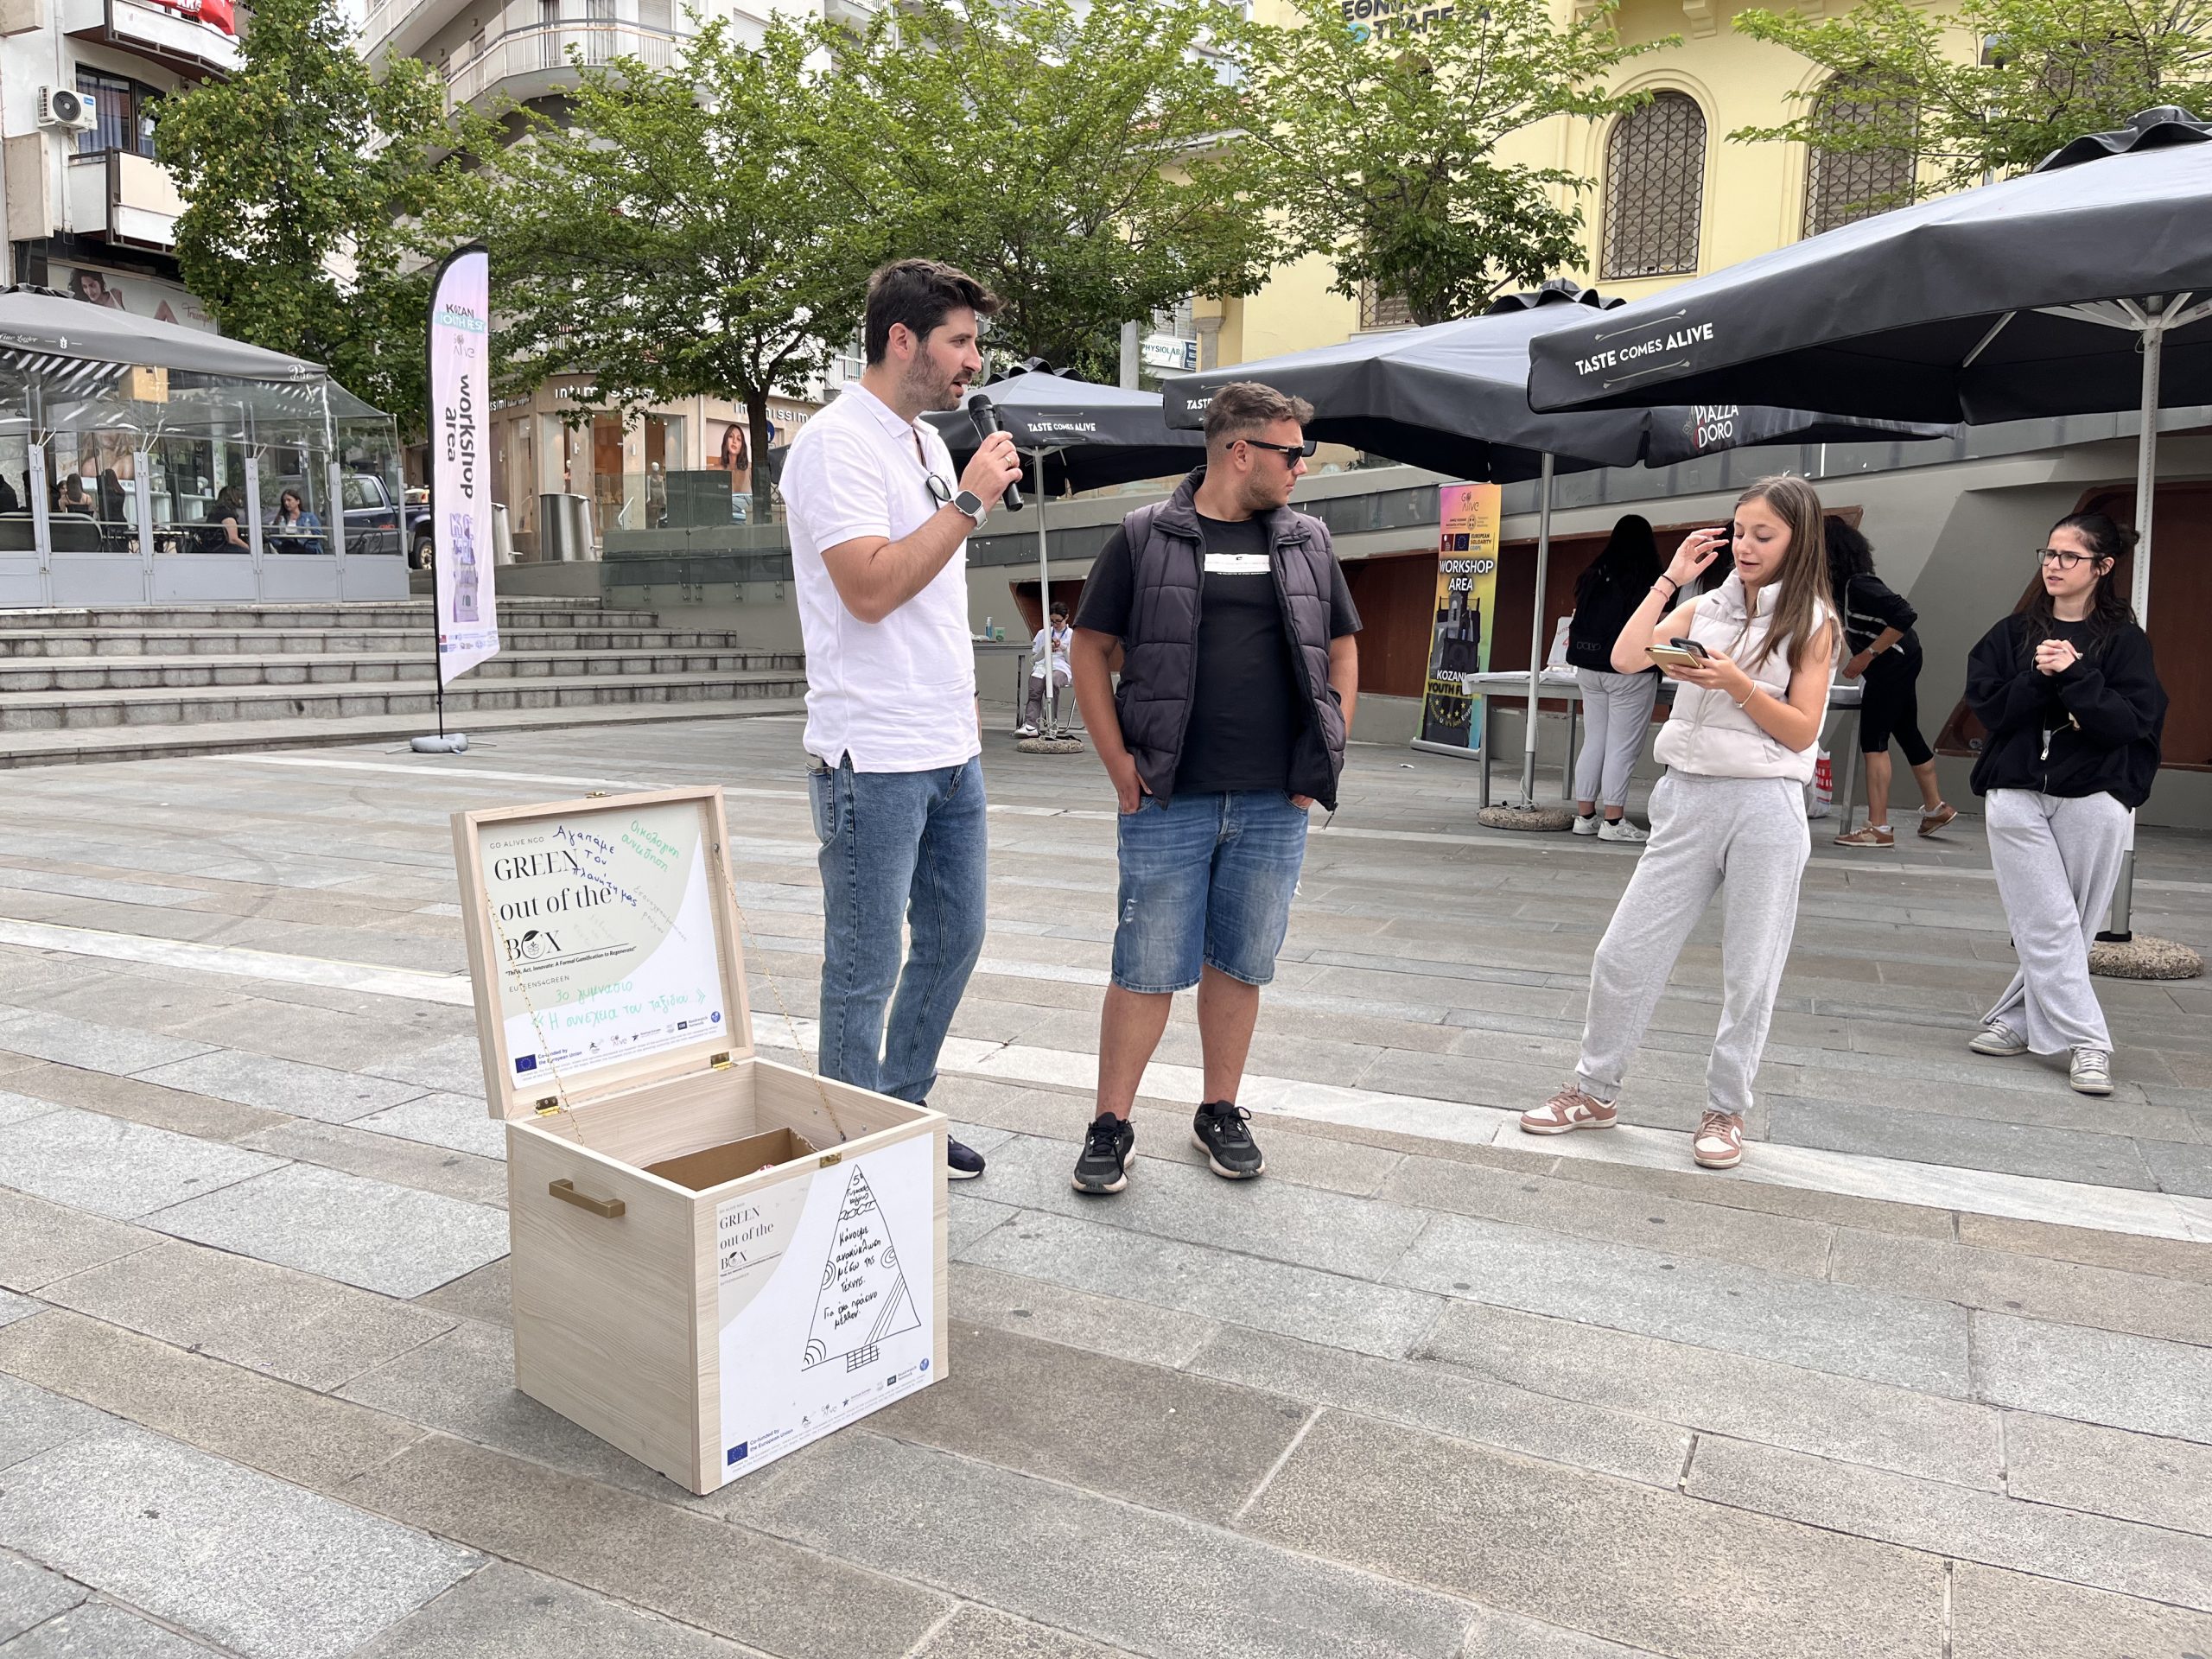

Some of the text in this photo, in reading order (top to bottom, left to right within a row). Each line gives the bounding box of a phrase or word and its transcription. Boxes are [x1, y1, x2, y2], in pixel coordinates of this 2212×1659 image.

[1575, 322, 1714, 376] TASTE COMES ALIVE
[1694, 404, 1739, 426] PIAZZA
[445, 406, 456, 462] area
[460, 373, 475, 499] workshop
[1027, 423, 1053, 432] TASTE
[1075, 423, 1096, 432] ALIVE
[1439, 559, 1494, 574] WORKSHOP
[1448, 577, 1473, 591] AREA
[1427, 682, 1454, 696] YOUTH
[504, 838, 525, 848] ALIVE
[494, 849, 580, 881] GREEN
[500, 884, 612, 921] out of the
[569, 1050, 582, 1058] Union
[720, 1205, 760, 1230] GREEN
[720, 1223, 774, 1249] out of the
[750, 1433, 772, 1446] Co-funded
[758, 1434, 779, 1450] European
[779, 1428, 794, 1440] Union
